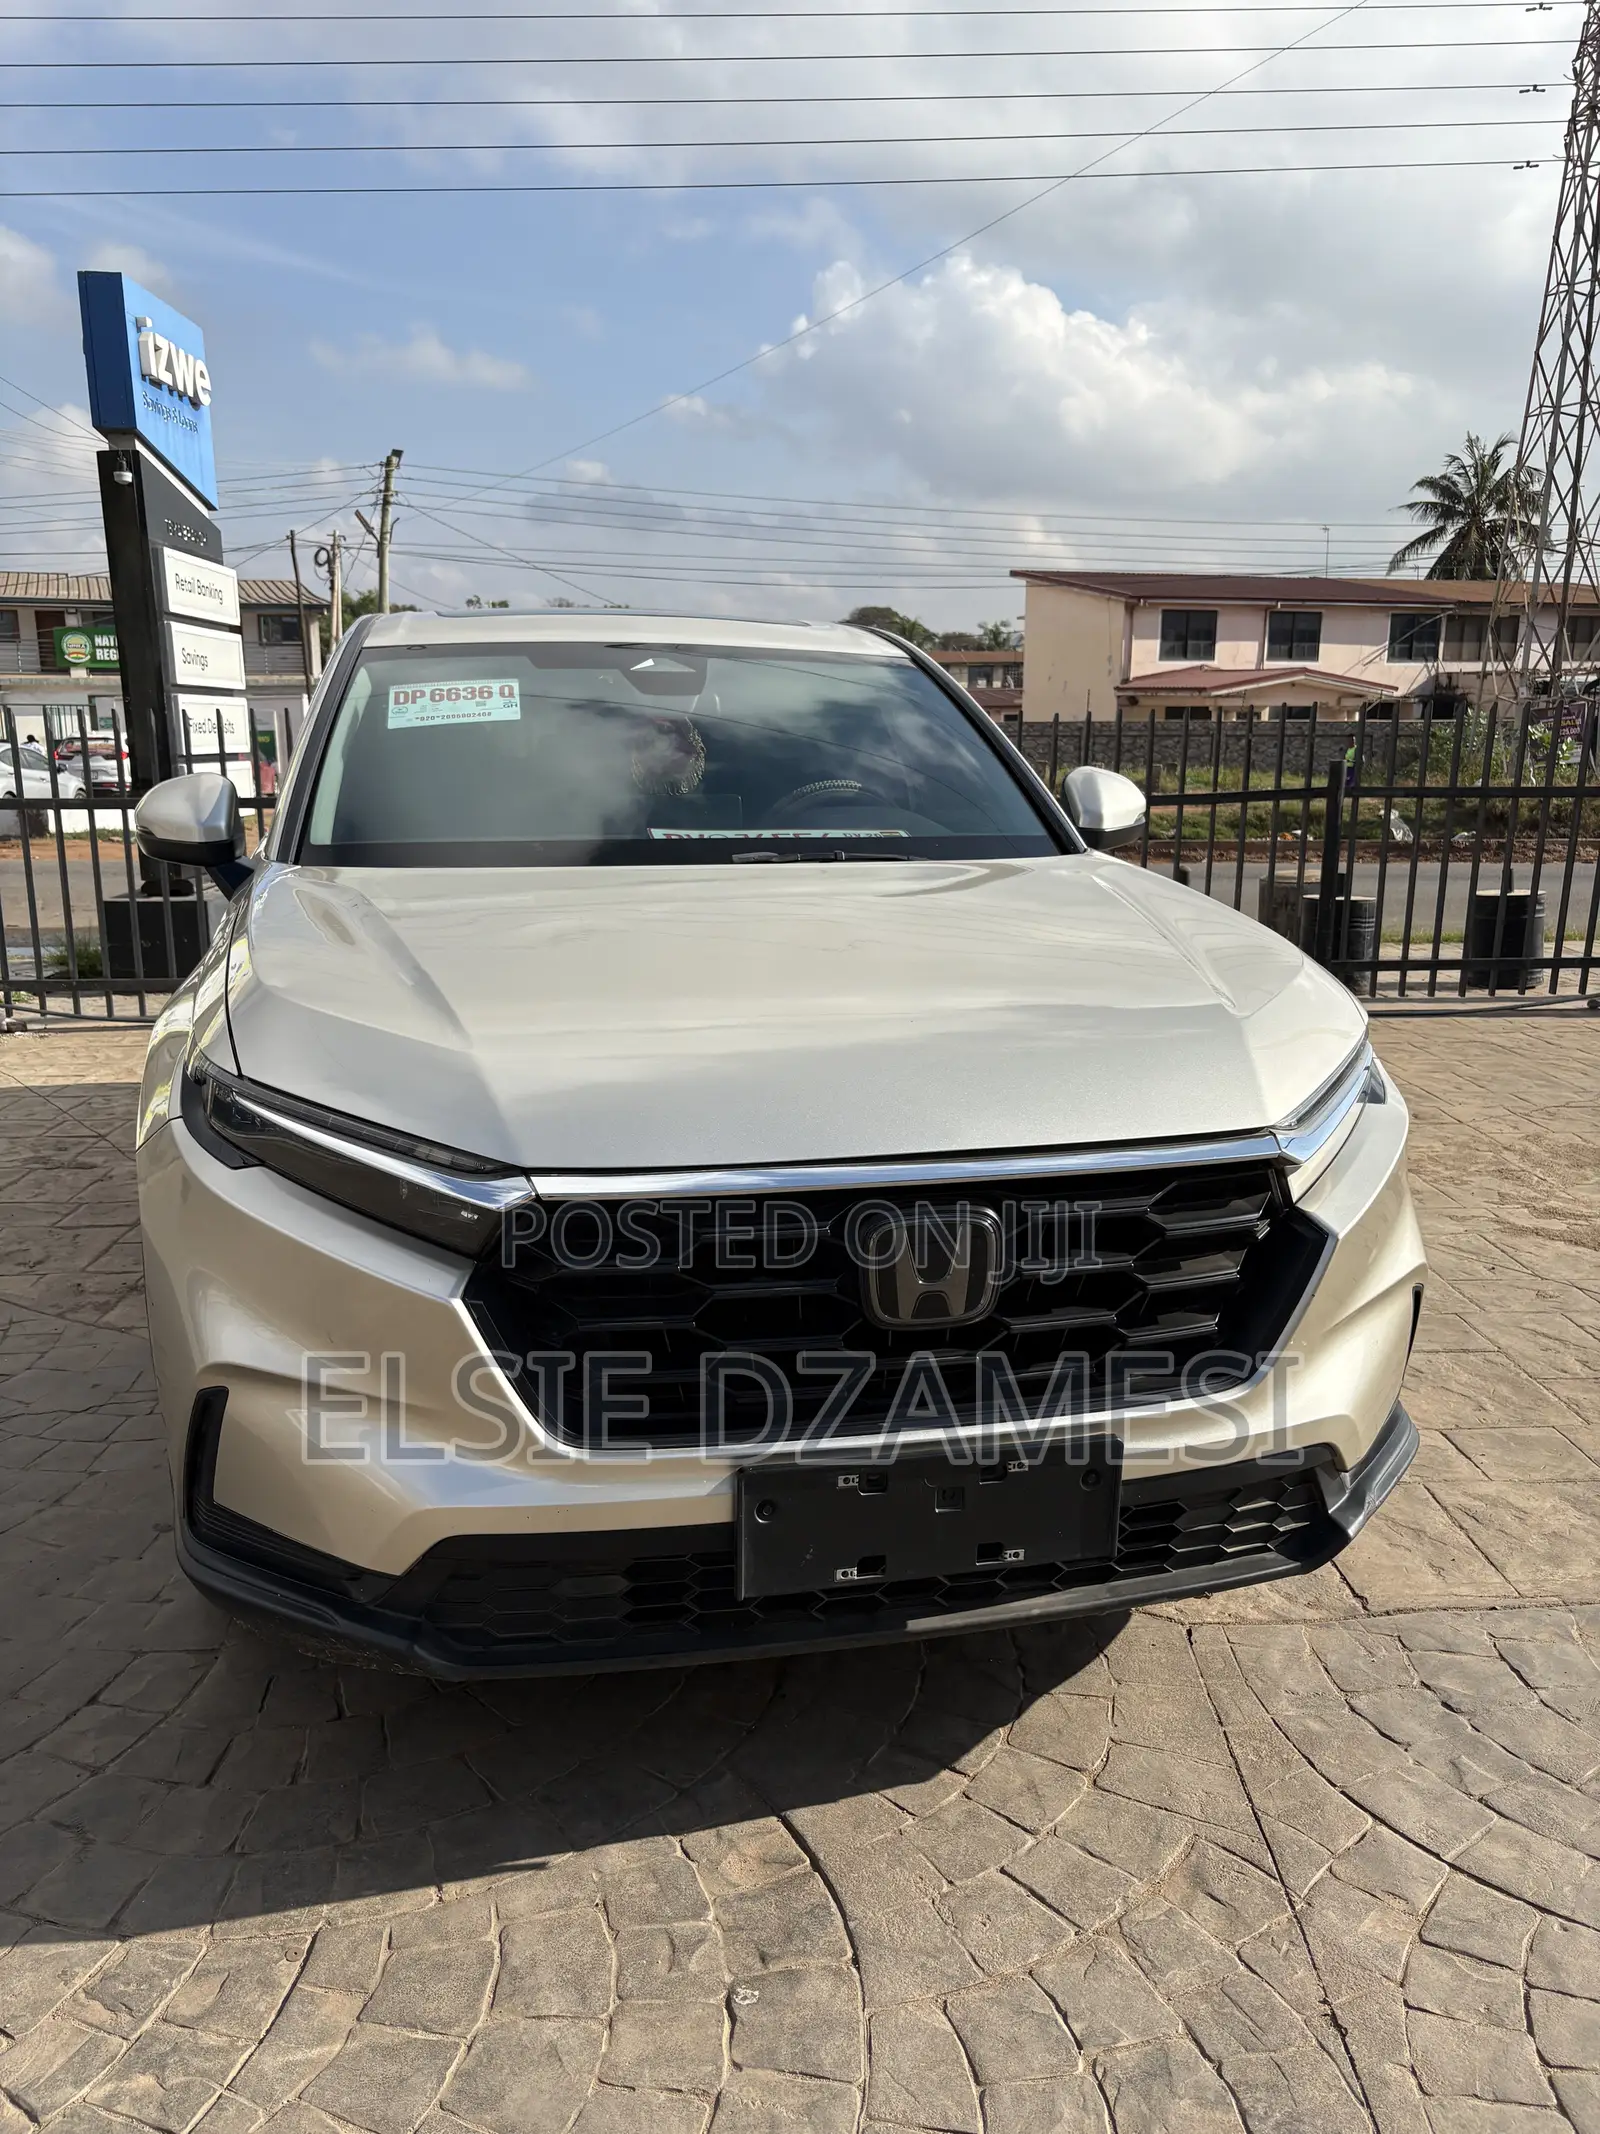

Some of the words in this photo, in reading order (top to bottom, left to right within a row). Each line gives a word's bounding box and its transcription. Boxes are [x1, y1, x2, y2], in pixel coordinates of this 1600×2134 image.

[138, 316, 212, 407] izwe
[174, 573, 196, 594] Retail
[197, 579, 223, 605] Banking
[95, 634, 118, 647] NATI
[96, 648, 119, 661] REG
[181, 647, 208, 671] Savings
[393, 690, 426, 706] DP
[429, 685, 493, 703] 6636
[499, 684, 516, 699] Q
[208, 718, 235, 734] Desits
